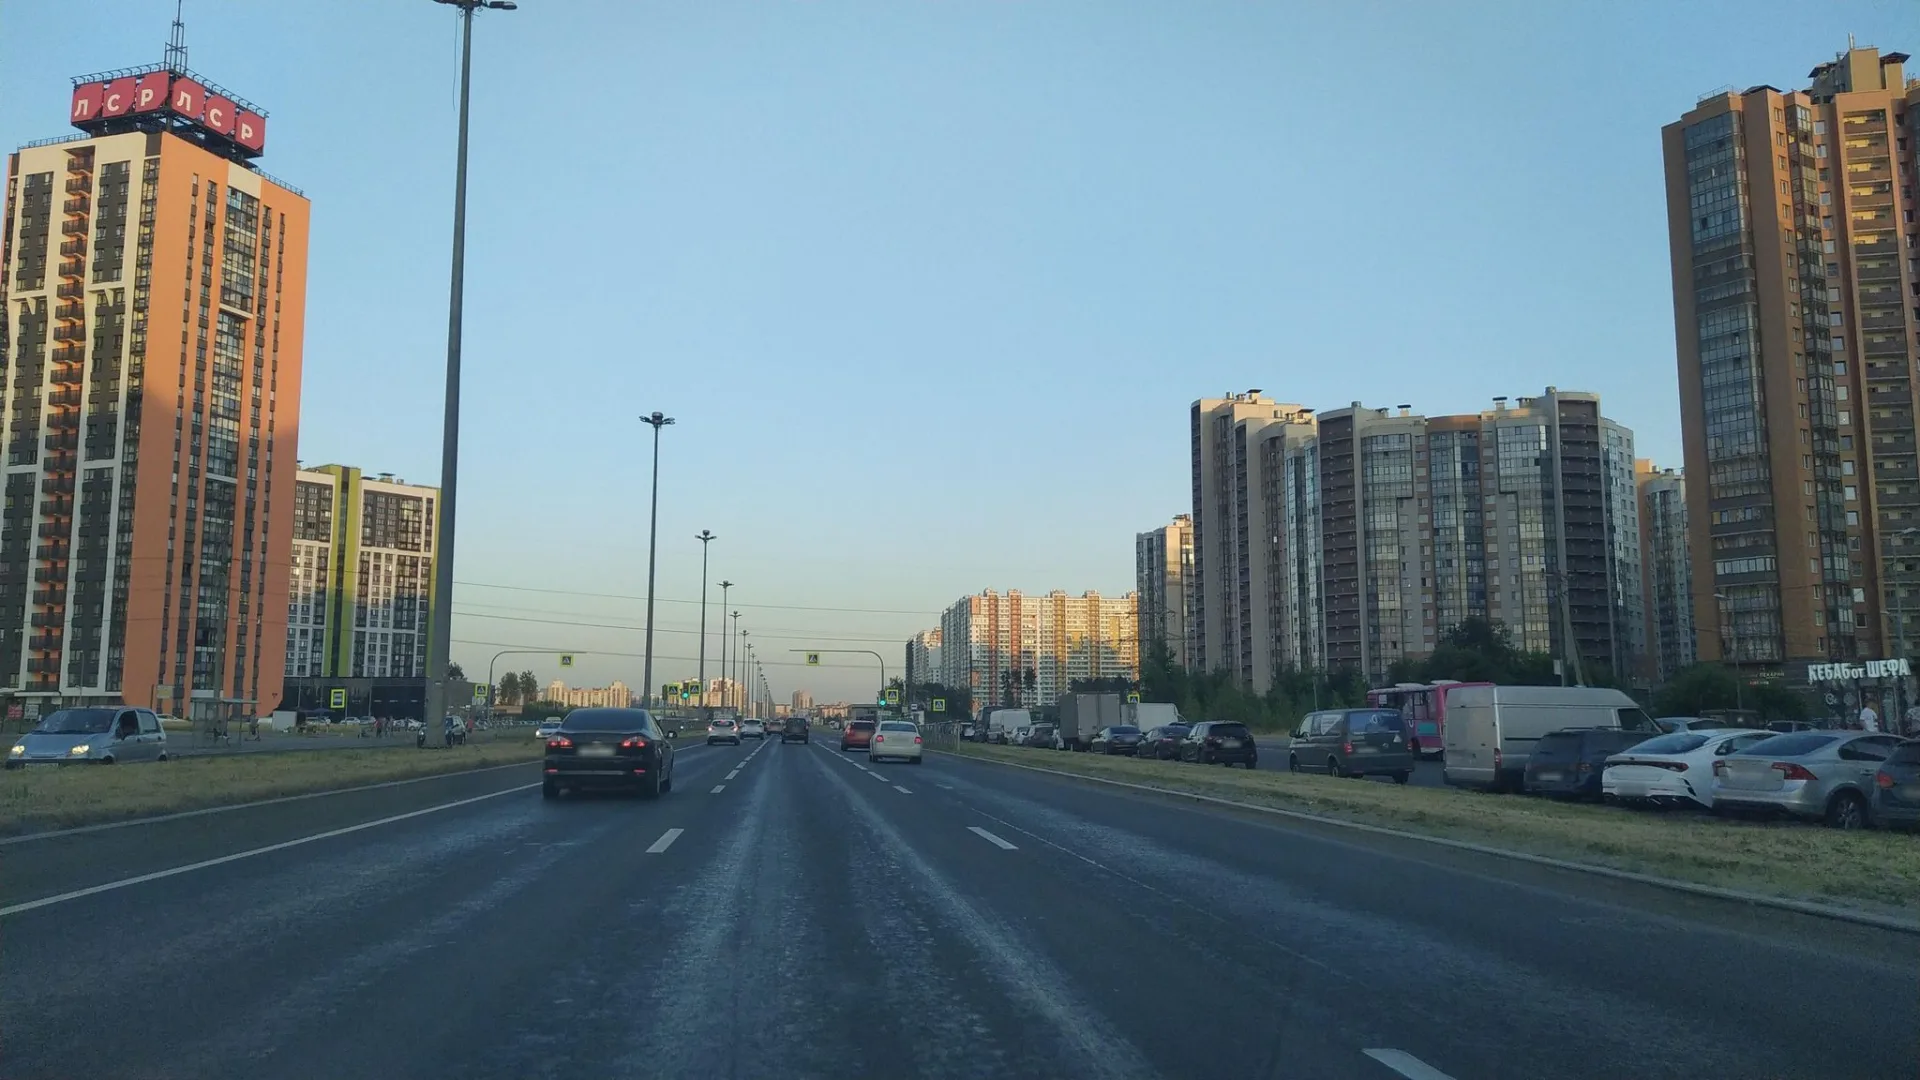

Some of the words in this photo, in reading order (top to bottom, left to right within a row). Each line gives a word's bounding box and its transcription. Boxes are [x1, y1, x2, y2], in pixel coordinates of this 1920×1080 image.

[74, 89, 153, 117] ЛСР
[177, 90, 253, 140] ЛСР
[1808, 663, 1850, 680] КЕБАБ
[1866, 658, 1911, 677] ШЕФА
